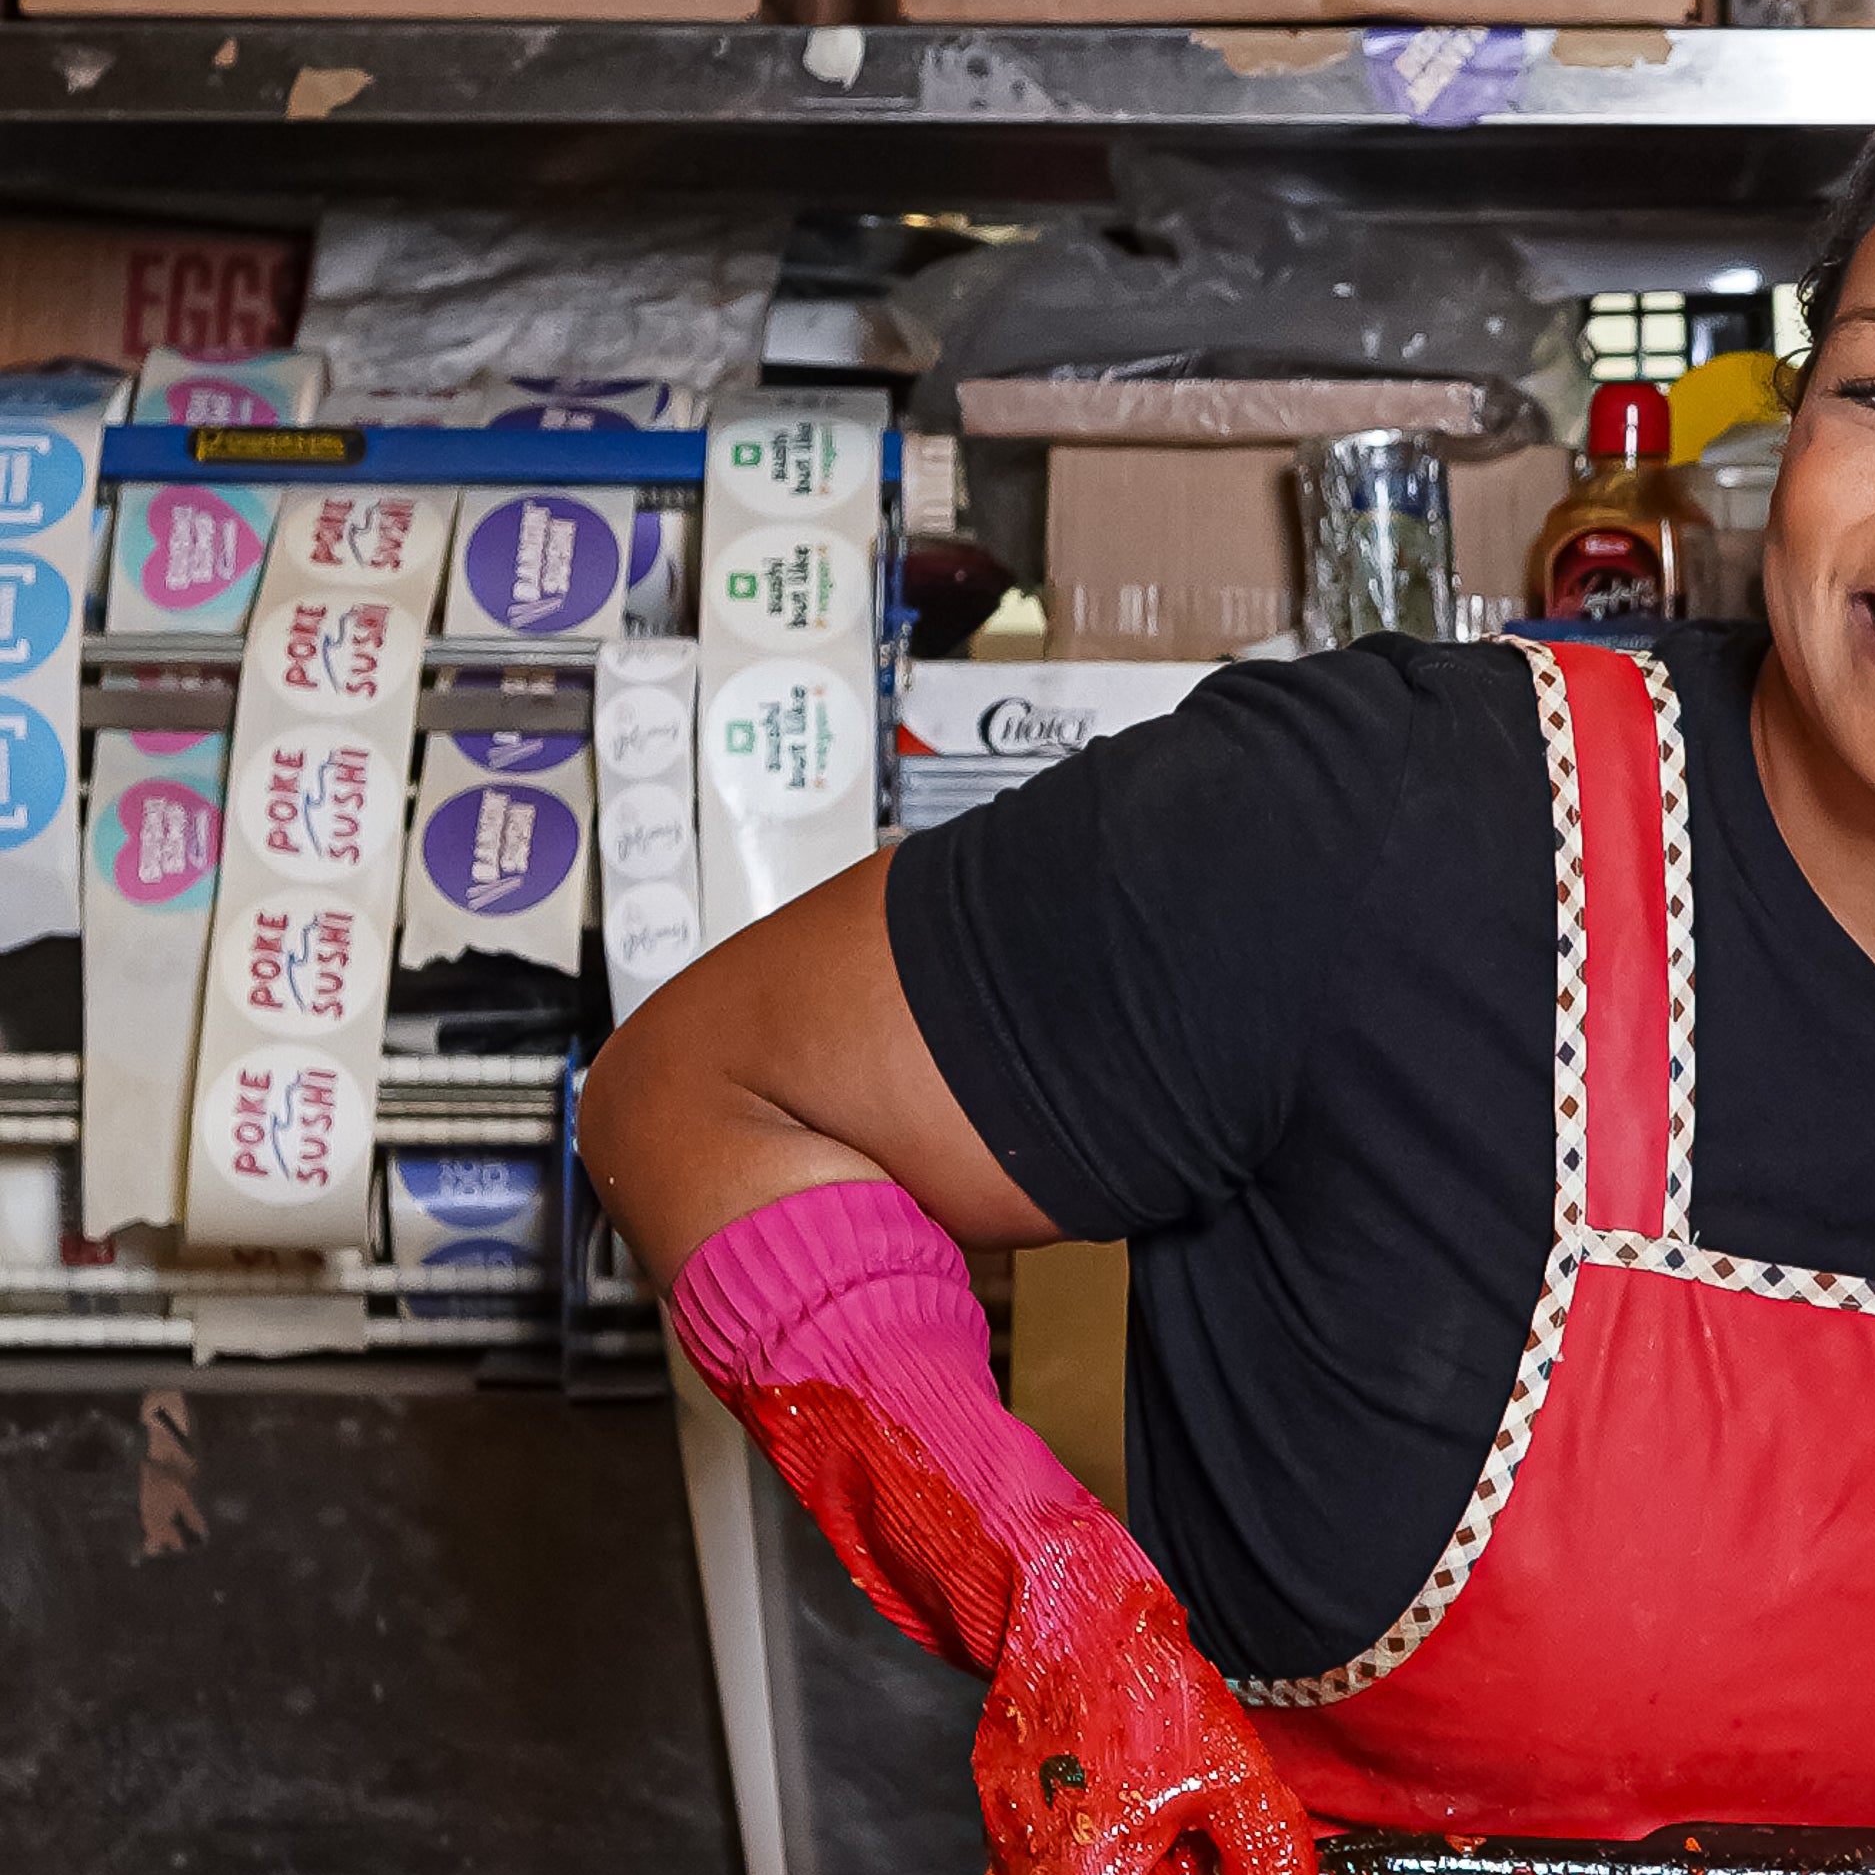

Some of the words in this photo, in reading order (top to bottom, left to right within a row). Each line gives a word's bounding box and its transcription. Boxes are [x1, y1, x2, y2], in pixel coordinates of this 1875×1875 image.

[282, 604, 329, 689] POKE
[344, 603, 391, 699] SUSHI
[265, 747, 305, 855] POKE
[327, 747, 370, 865] SUSHI
[248, 911, 290, 1010] POKE
[310, 911, 355, 1022] SUSHI
[232, 1068, 273, 1178] POKE
[296, 1068, 339, 1188] SUSHI
